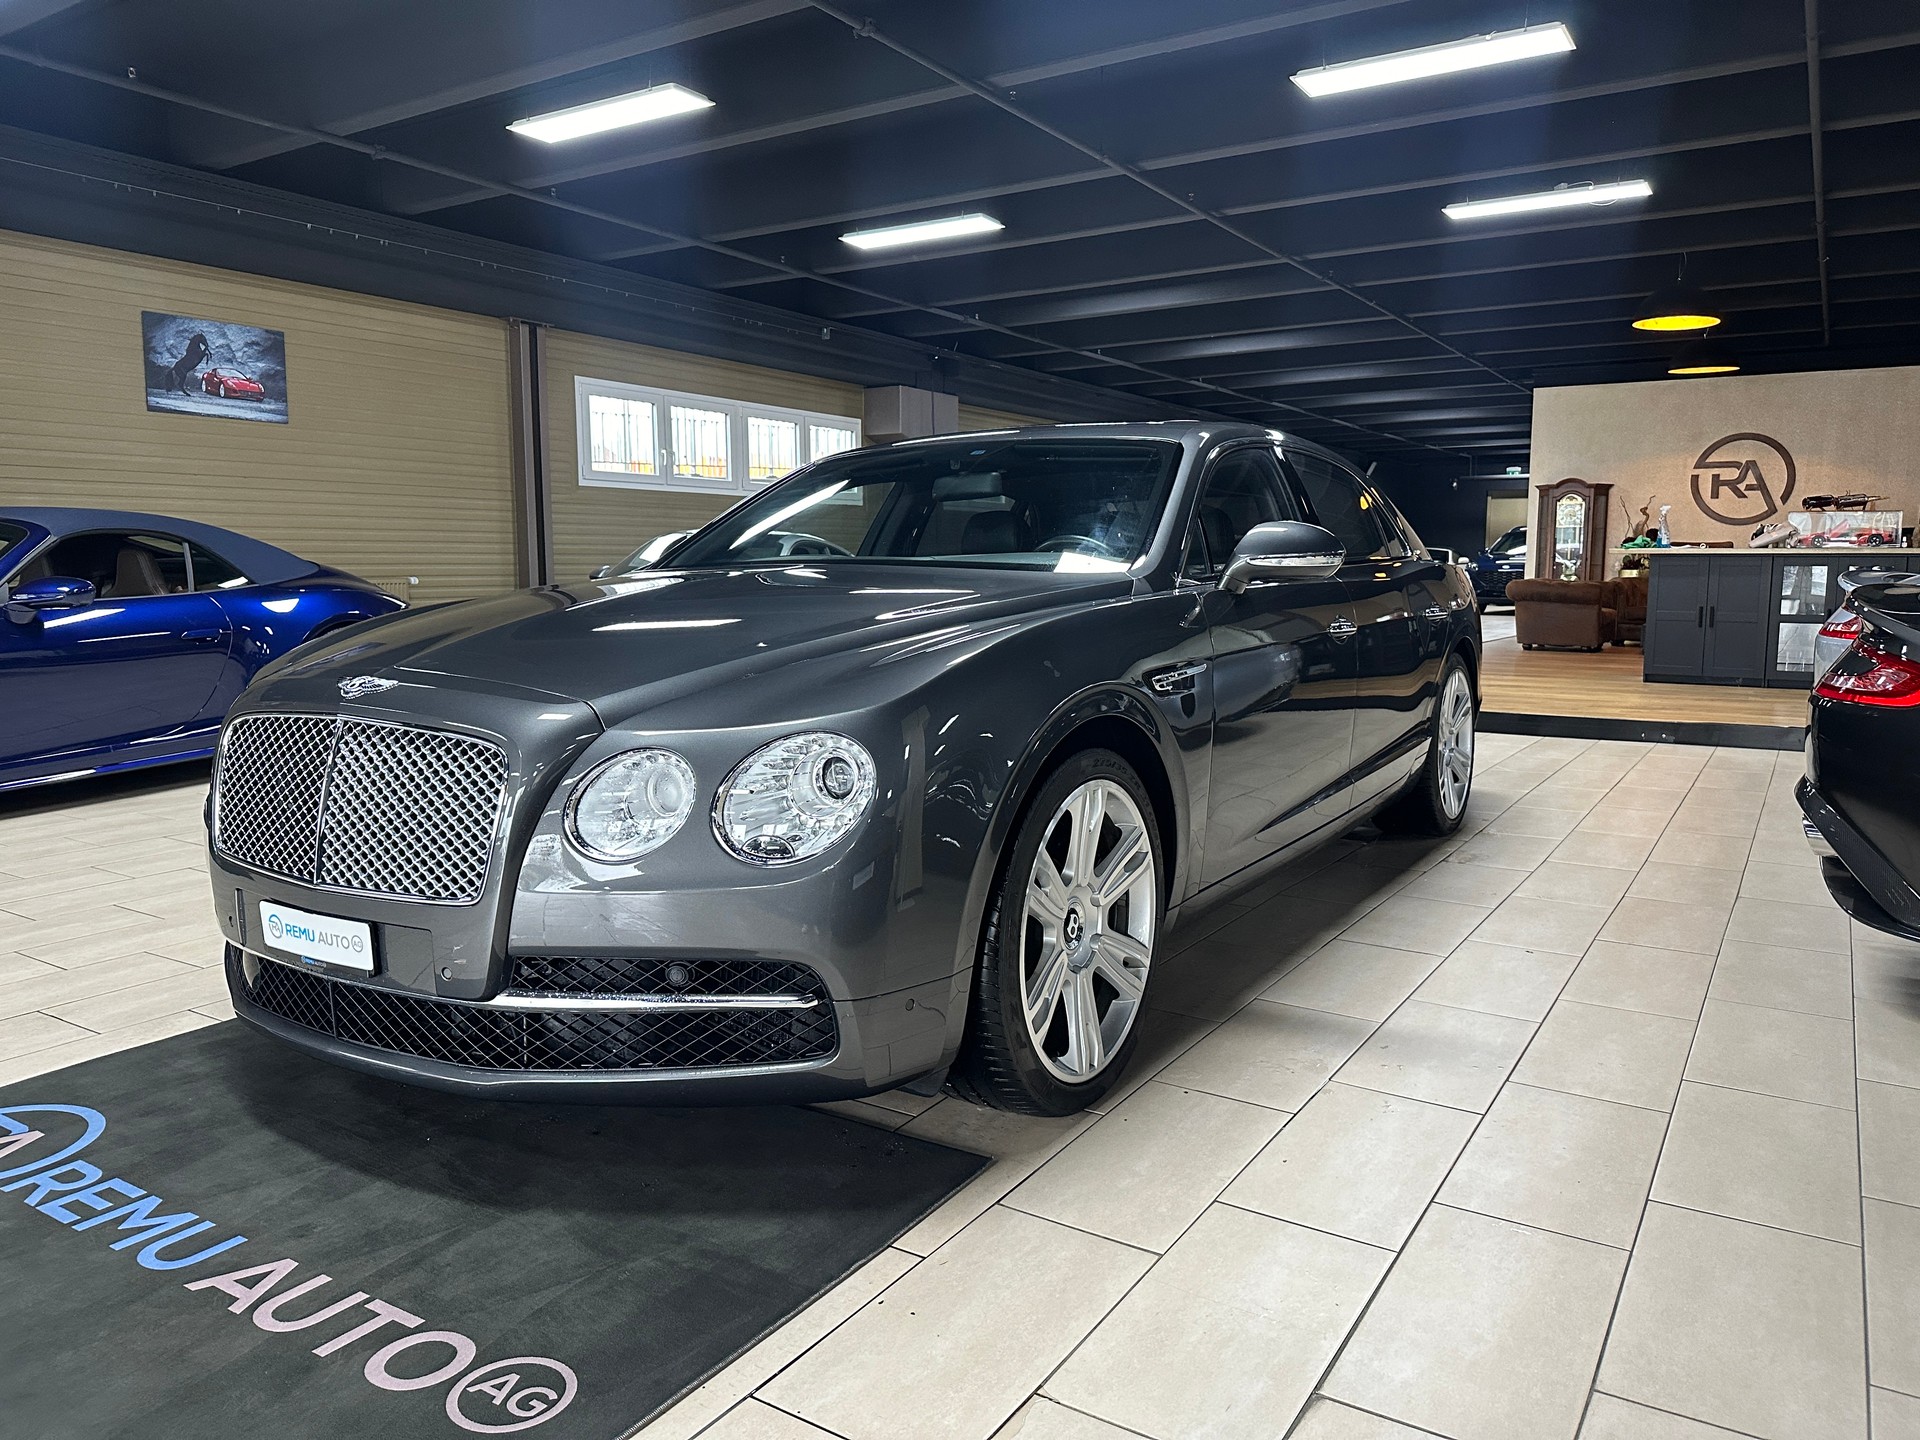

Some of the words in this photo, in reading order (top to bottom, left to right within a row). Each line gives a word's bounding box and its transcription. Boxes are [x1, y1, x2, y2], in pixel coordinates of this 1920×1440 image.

[285, 923, 315, 942] REMU
[318, 931, 350, 949] AUTO
[0, 1159, 248, 1270] REMU
[183, 1258, 476, 1391] AUTO
[467, 1373, 558, 1418] AG
